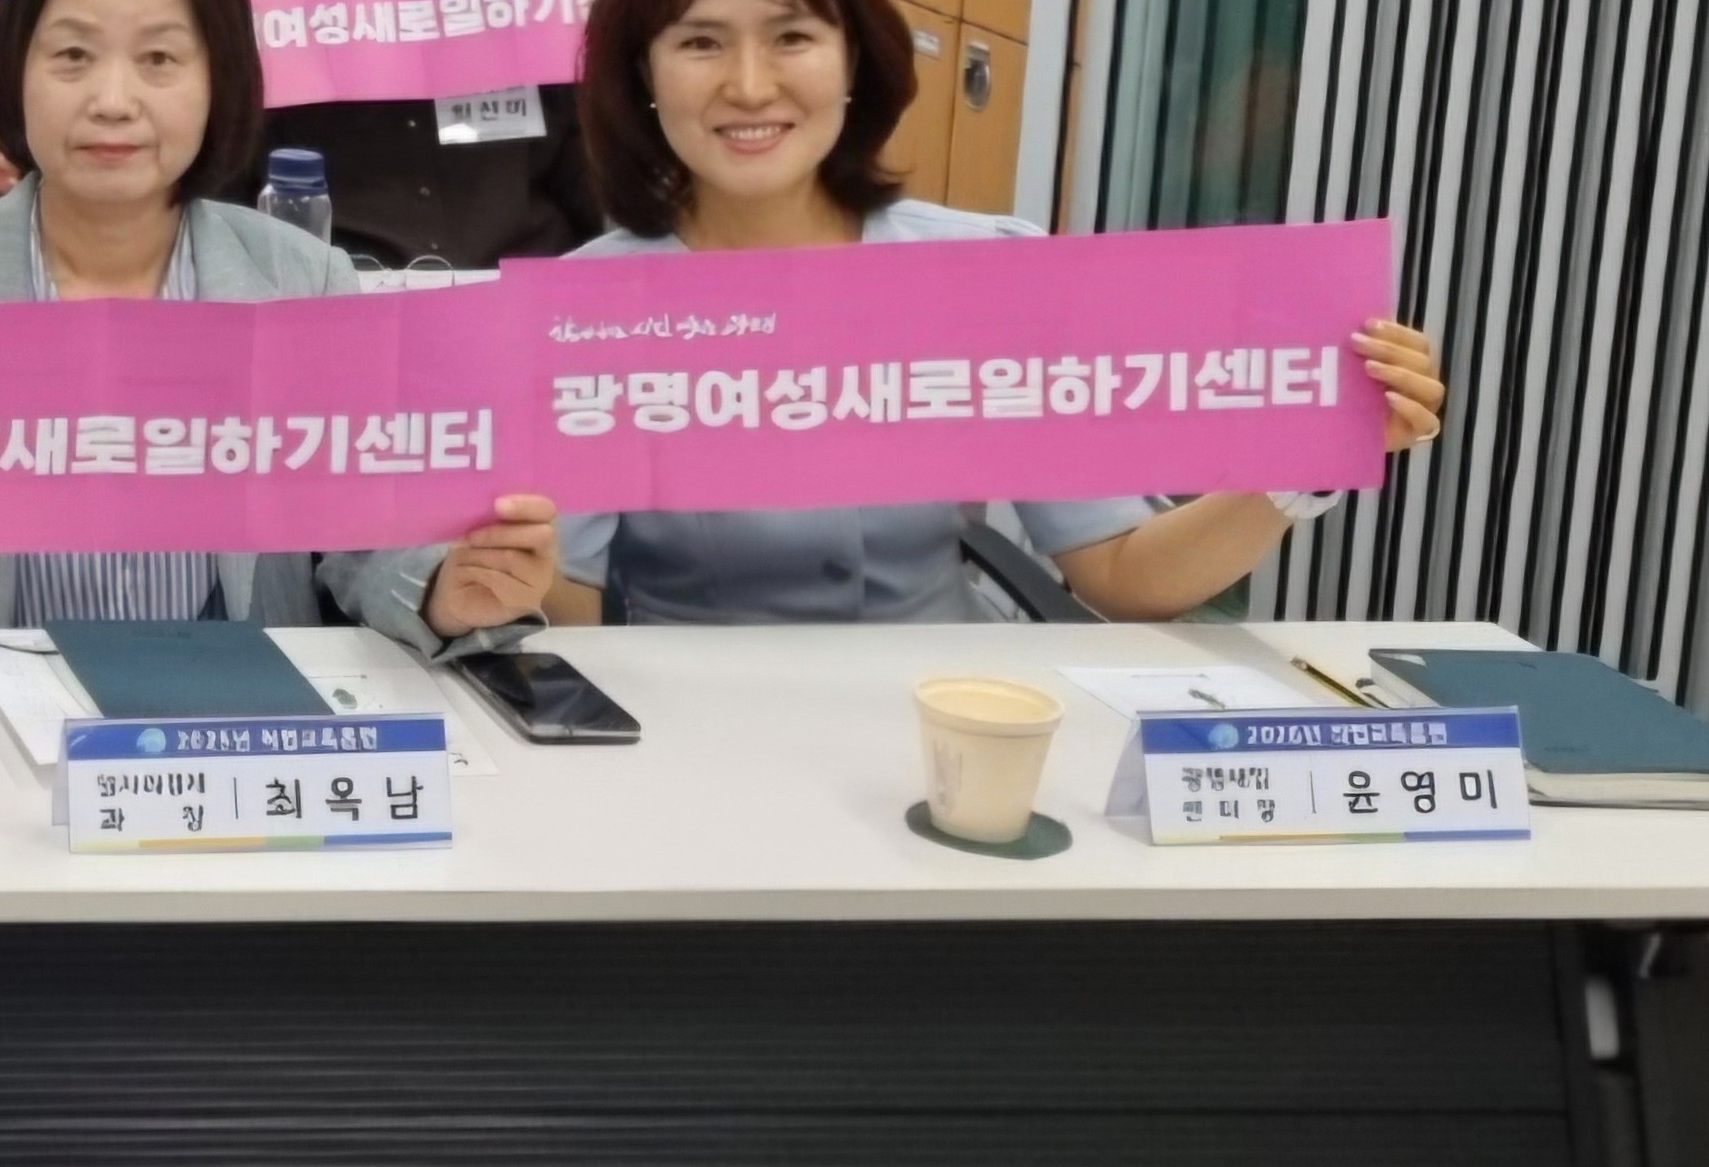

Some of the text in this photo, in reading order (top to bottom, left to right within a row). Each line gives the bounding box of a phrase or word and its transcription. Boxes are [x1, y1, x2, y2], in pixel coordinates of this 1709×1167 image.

[554, 347, 1337, 435] 광명여성새로일하기센터
[265, 775, 424, 823] 최옥남
[1342, 769, 1499, 816] 윤영미
